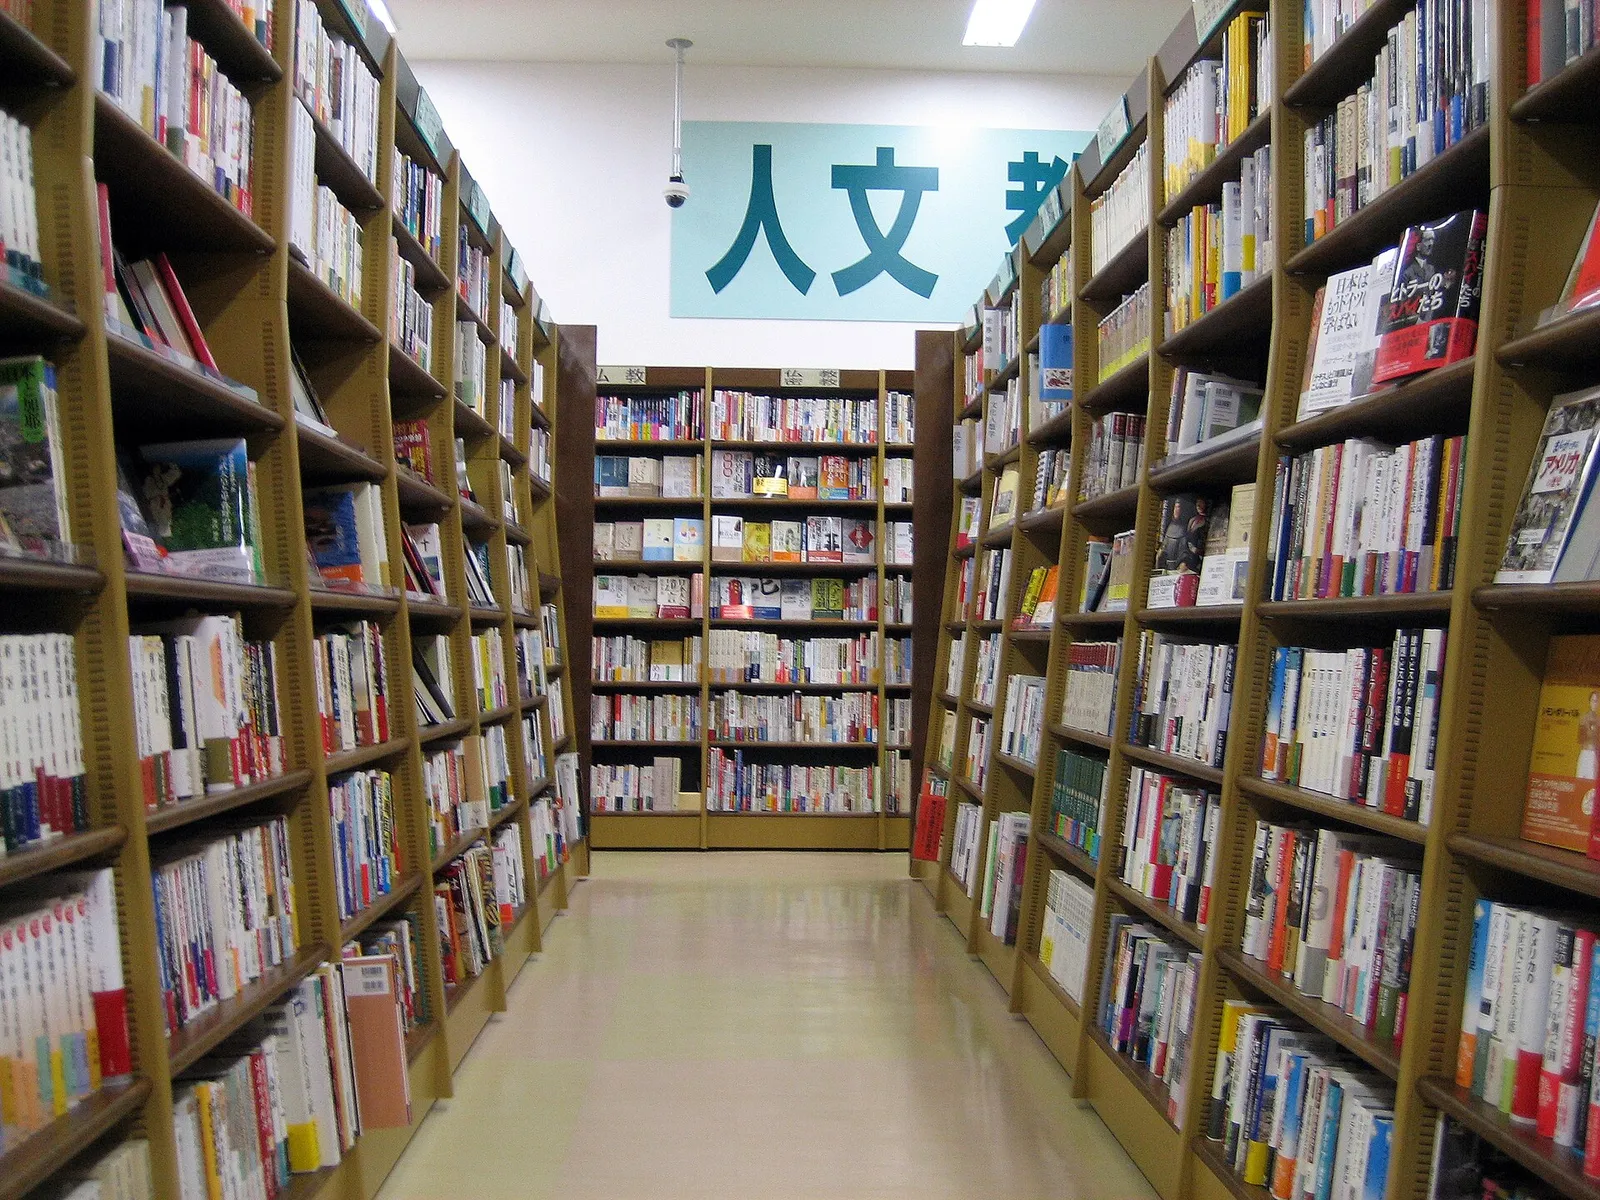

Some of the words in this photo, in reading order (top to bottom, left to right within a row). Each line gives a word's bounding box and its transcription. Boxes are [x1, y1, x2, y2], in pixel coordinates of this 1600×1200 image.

[1336, 272, 1369, 295] 日本は
[1391, 272, 1442, 303] ヒトラーの
[1539, 450, 1580, 479] アメリカ
